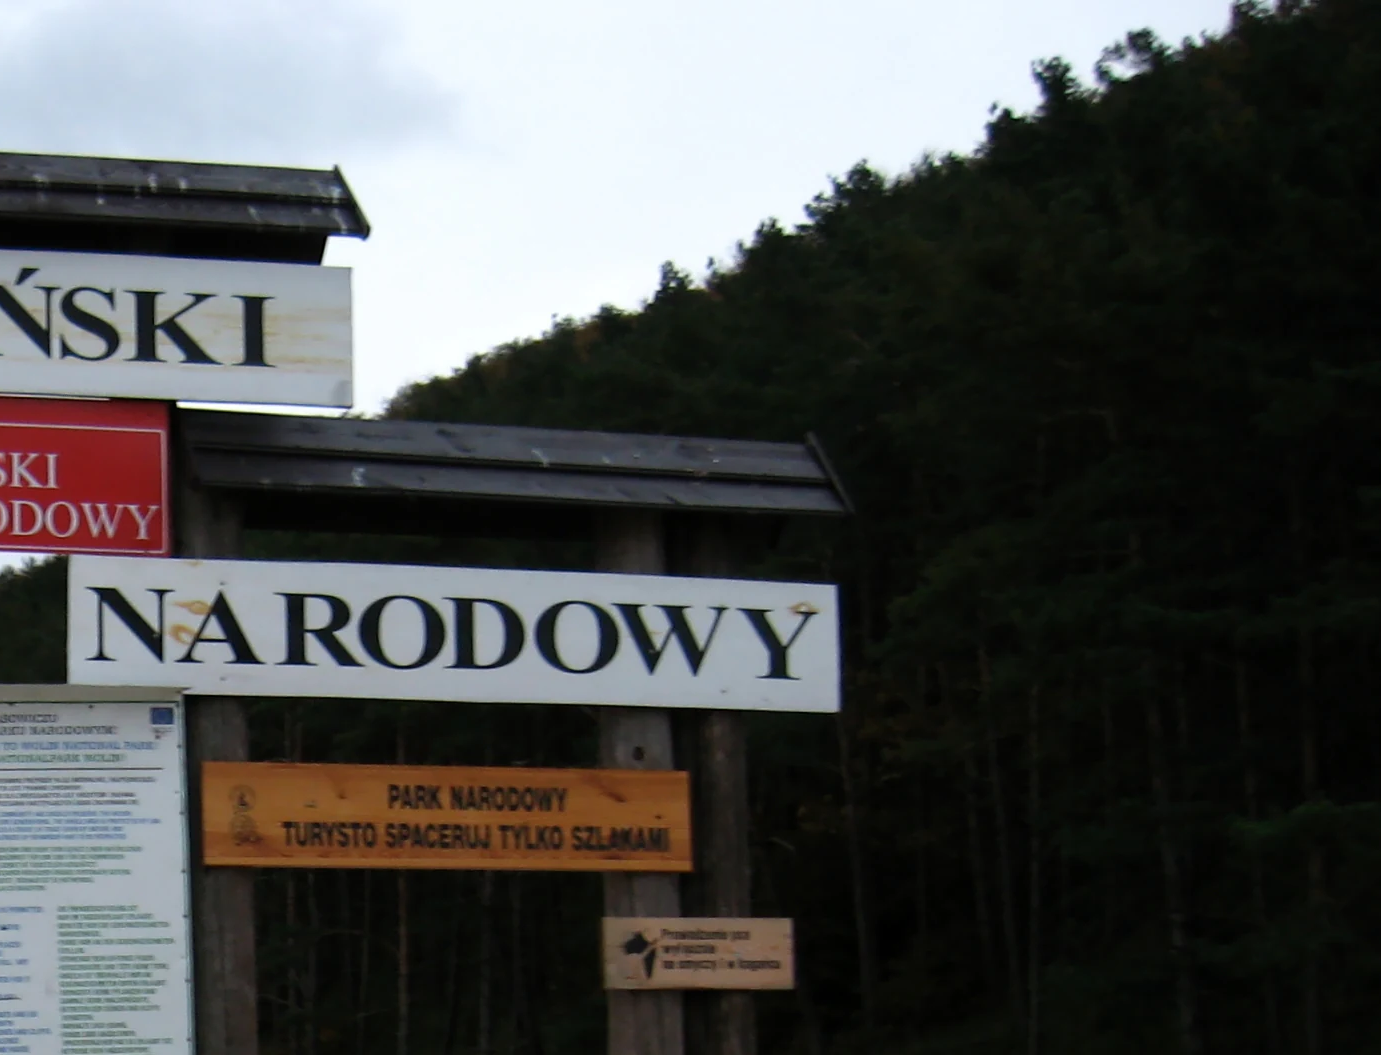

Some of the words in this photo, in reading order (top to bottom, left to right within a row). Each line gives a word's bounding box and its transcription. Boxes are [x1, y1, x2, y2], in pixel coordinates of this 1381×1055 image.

[84, 584, 822, 682] NARODOWY
[387, 783, 443, 811] PARK
[450, 785, 568, 813] NARODOWY
[282, 820, 377, 849] TURYSTO
[385, 822, 492, 850] SPACERUJ
[498, 824, 565, 852] TYLKO
[571, 825, 671, 854] SZLAKAMI
